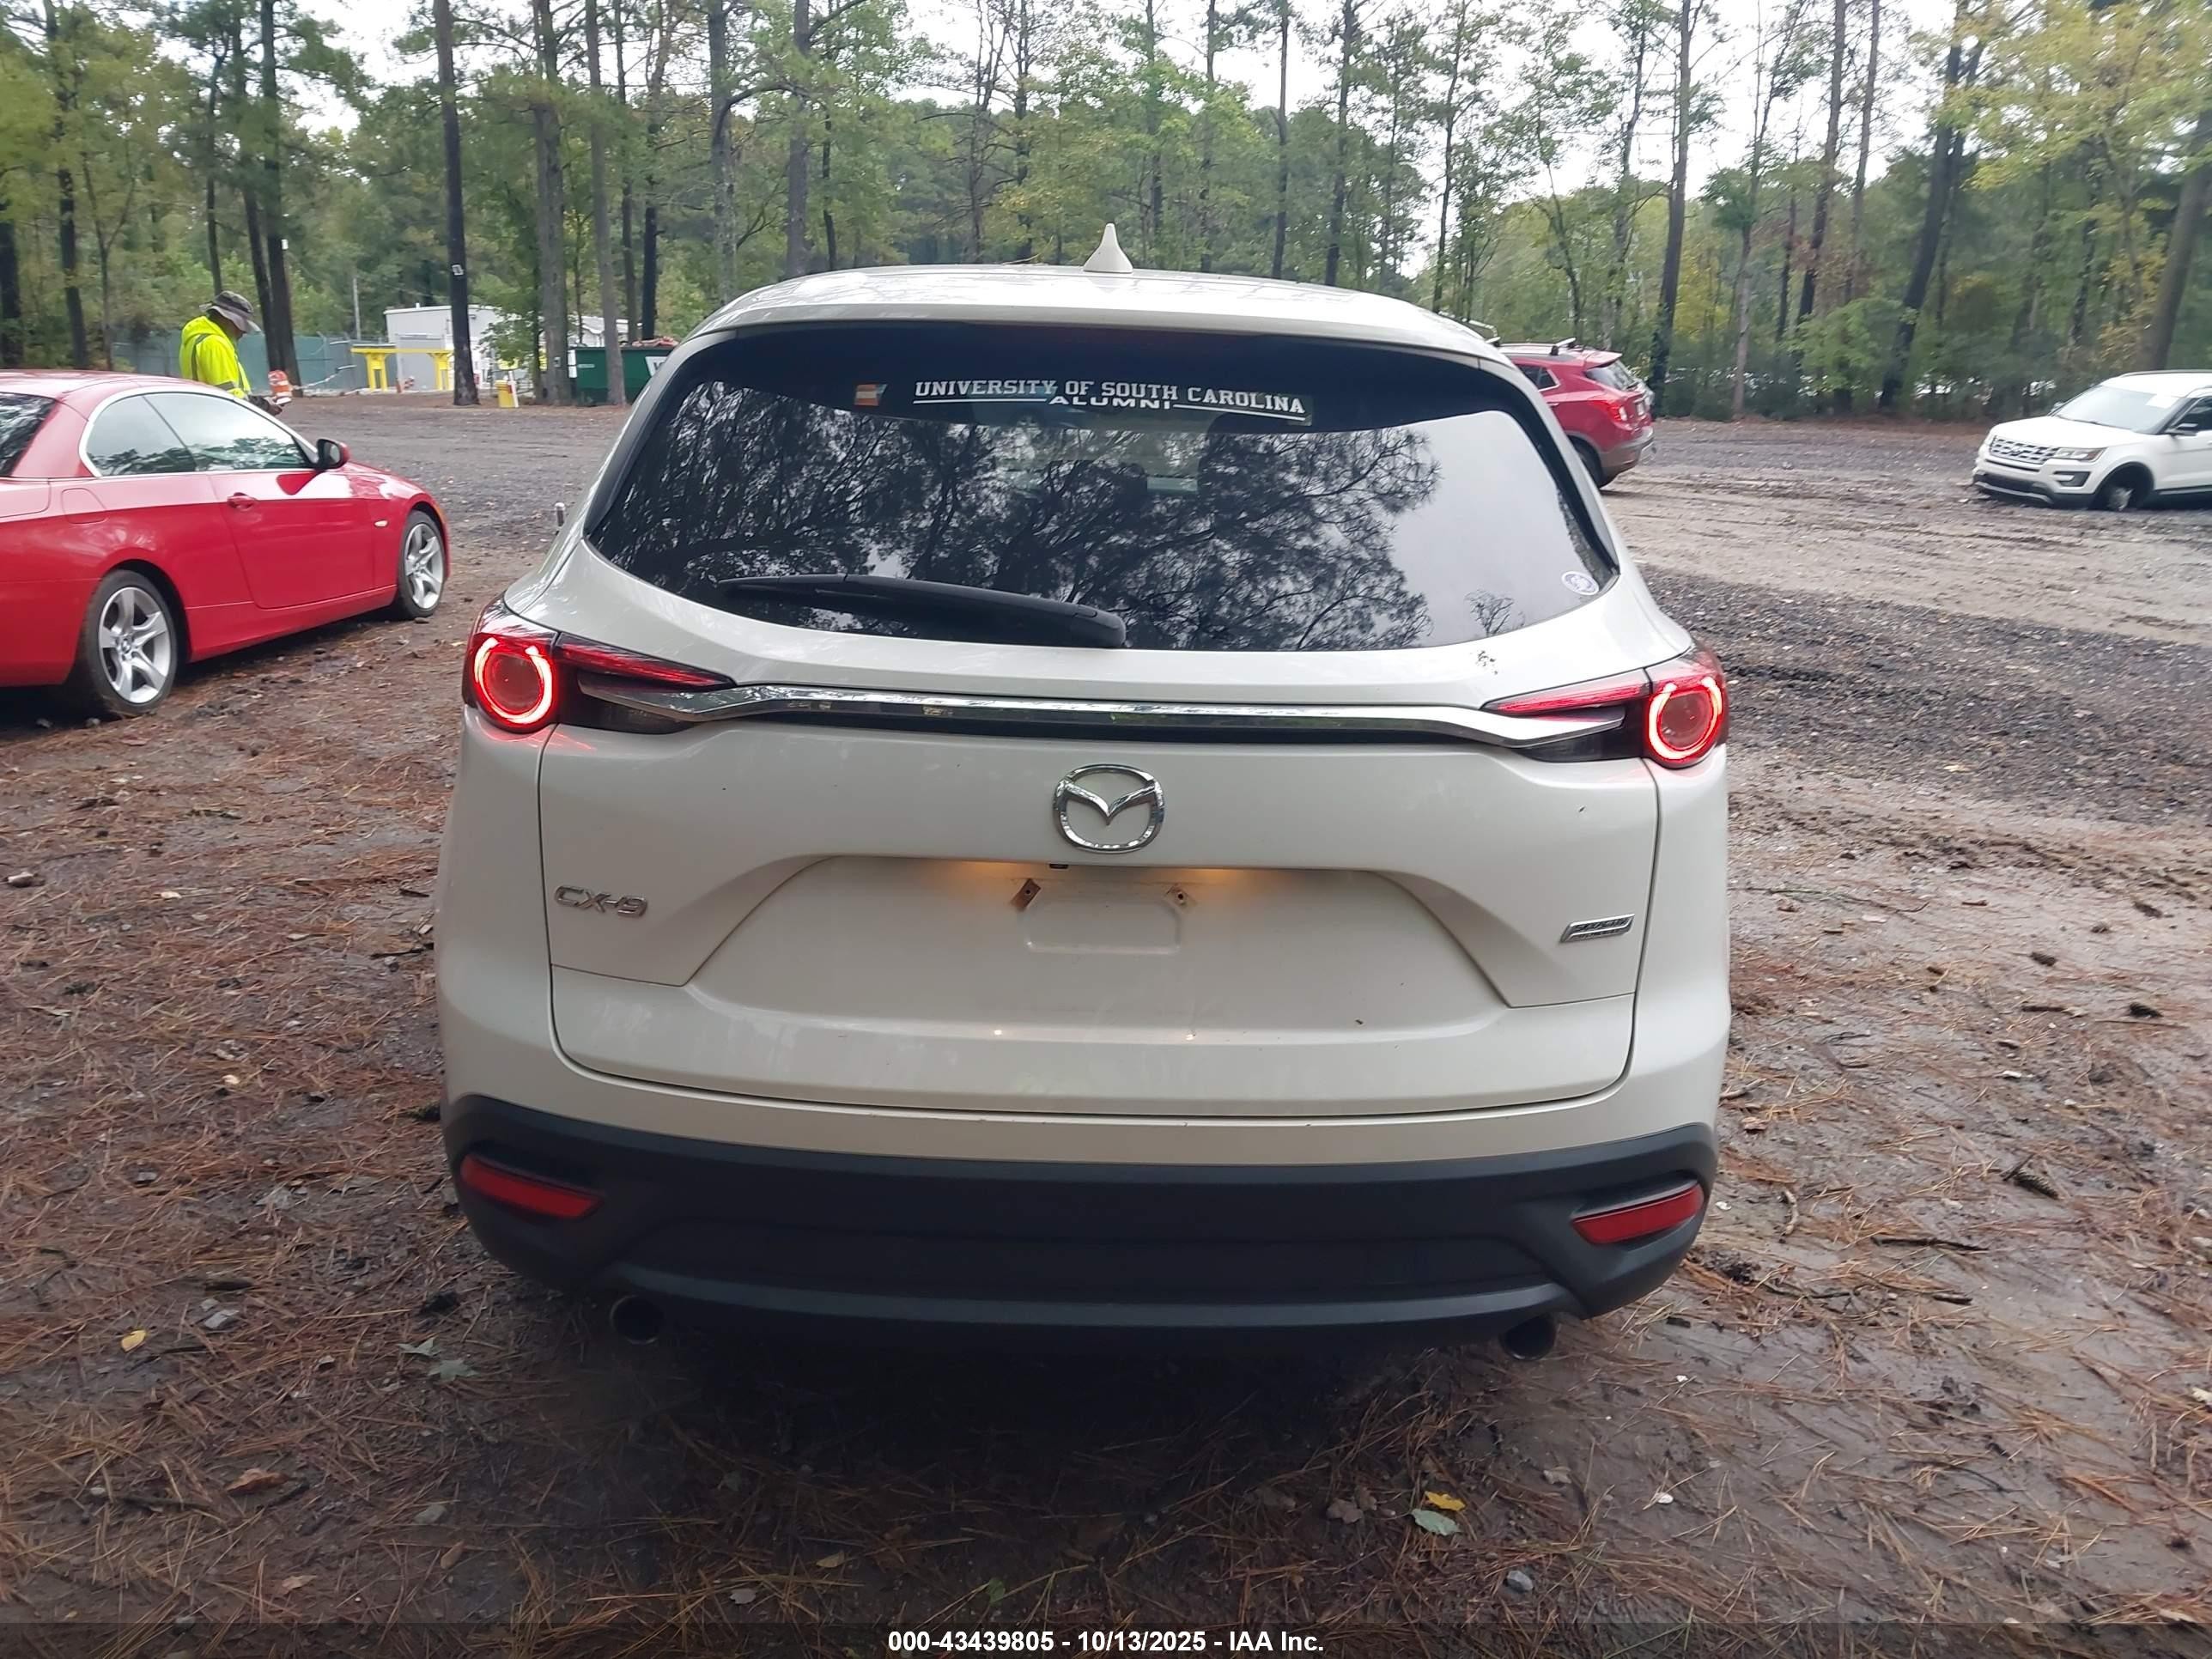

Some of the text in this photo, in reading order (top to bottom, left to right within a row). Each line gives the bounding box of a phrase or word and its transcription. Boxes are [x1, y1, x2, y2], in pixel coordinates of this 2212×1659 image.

[915, 380, 1306, 414] UNIVERSITY OF SOUTH CAROLINA
[1048, 396, 1170, 410] ALUMNI
[554, 885, 648, 918] CX-9
